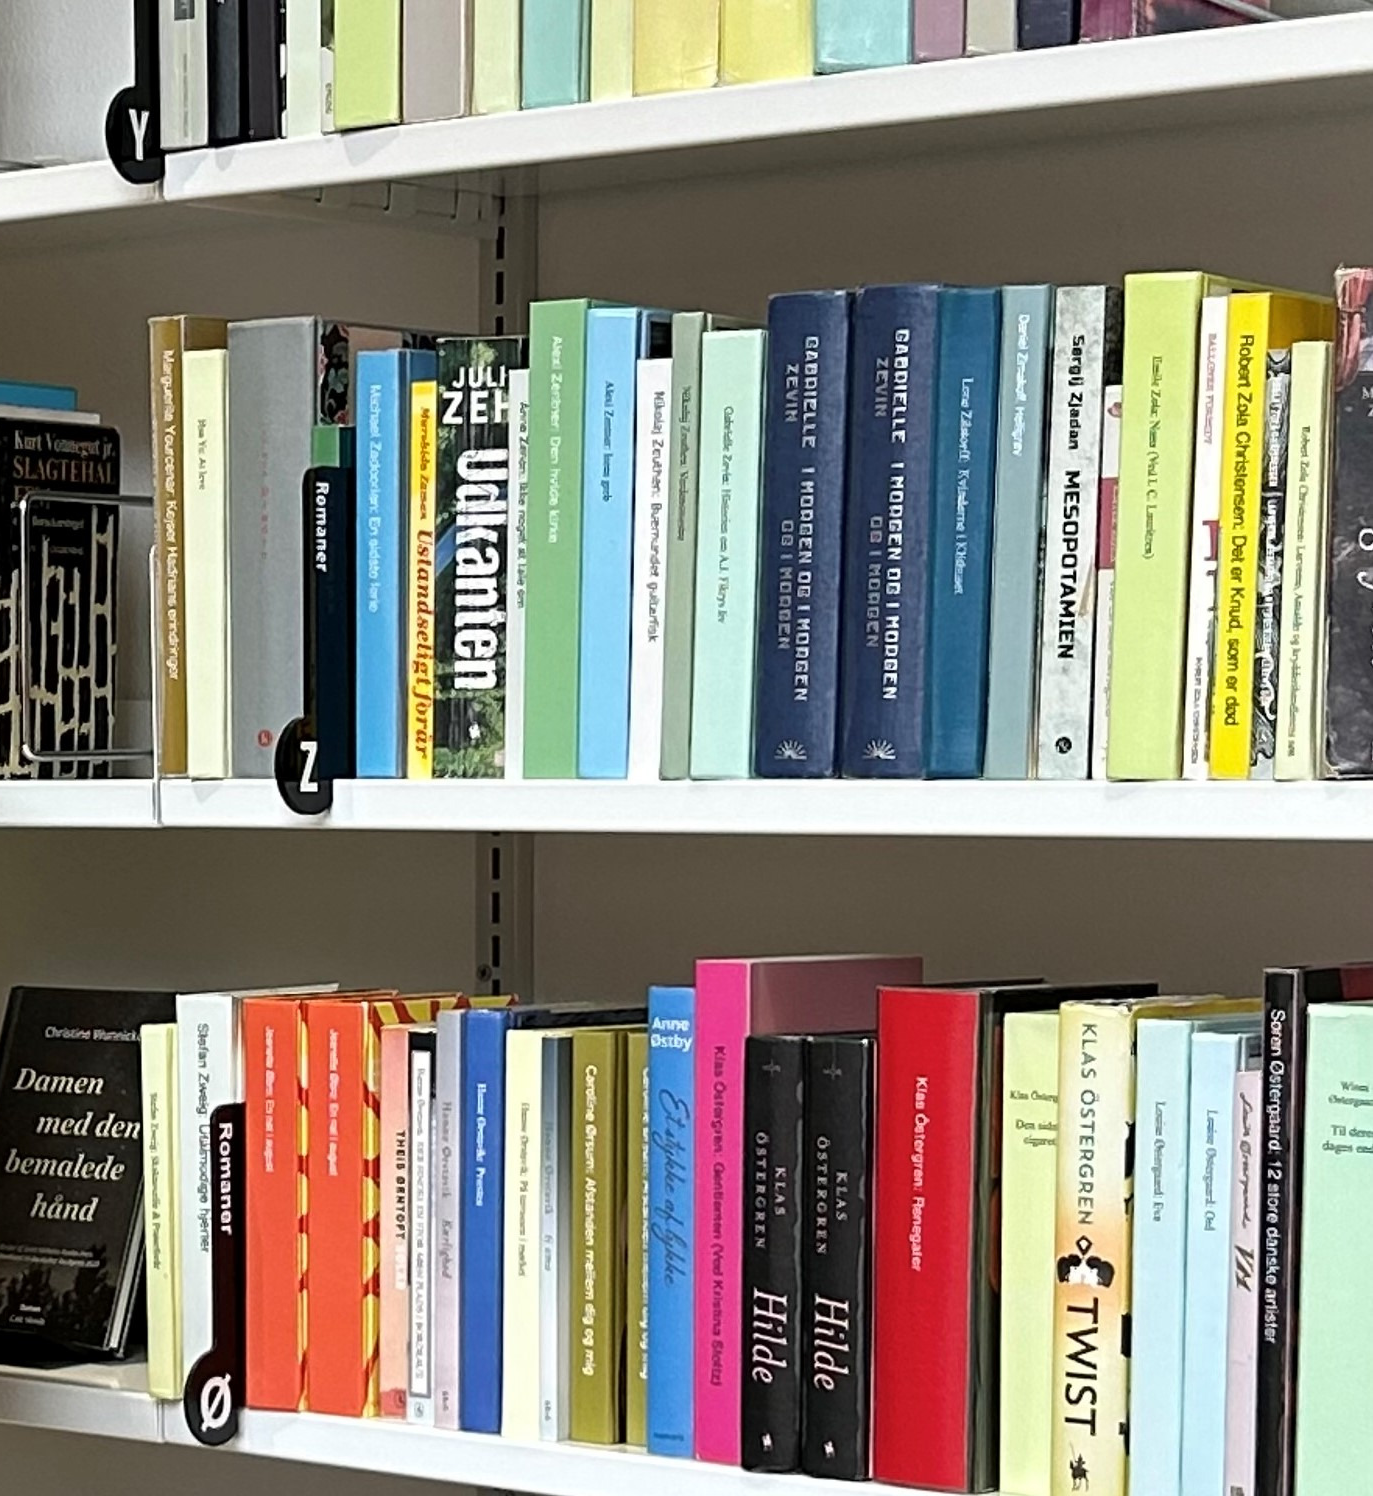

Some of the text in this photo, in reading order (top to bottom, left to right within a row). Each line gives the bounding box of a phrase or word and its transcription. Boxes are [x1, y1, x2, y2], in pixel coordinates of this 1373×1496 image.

[128, 108, 150, 161] Y
[785, 363, 797, 423] ZEVIN
[801, 336, 818, 449] GABRIELLE
[875, 357, 888, 418] ZEVIN
[892, 328, 909, 443] GABRIELLE
[1067, 335, 1085, 449] Sergij Zjadan
[13, 456, 116, 484] SLAGTEHAL
[14, 429, 42, 450] Kurt
[315, 481, 329, 572] Romaner
[798, 481, 814, 564] MORGEN
[888, 476, 903, 561] MORGEN
[1225, 334, 1253, 726] Robert Zola Christensen: Det er Knud, som er død
[452, 449, 508, 689] Udkanten
[797, 571, 812, 598] OG
[886, 568, 902, 595] OG
[1058, 470, 1080, 659] MESOPOTAMIEN
[778, 567, 792, 649] MORGEN
[866, 564, 881, 647] MORGEN
[412, 529, 435, 760] Ustandseligt forår
[794, 619, 810, 701] MORGEN
[883, 616, 899, 699] MORGEN
[300, 741, 318, 792] Z
[196, 1023, 210, 1068] Stefan
[651, 1033, 693, 1052] Østby
[652, 1016, 691, 1031] Anne
[13, 1068, 105, 1096] Damen
[196, 1072, 211, 1119] Zweig:
[584, 1065, 597, 1121] Caroline
[914, 1077, 927, 1110] Klas
[35, 1112, 141, 1140] med den
[1078, 1023, 1101, 1225] KLAS ÖSTERGREN
[5, 1148, 125, 1182] bemalede
[219, 1123, 233, 1235] Romaner
[755, 1132, 770, 1248] ÖSTERGREN
[774, 1167, 786, 1216] KLAS
[816, 1136, 830, 1255] ÖSTERGREN
[1263, 1009, 1286, 1344] Søren Østergaard: 12 store danske artister
[29, 1193, 99, 1223] hånd
[584, 1178, 597, 1245] Afstanden
[835, 1172, 848, 1221] KLAS
[581, 1303, 596, 1324] dig
[581, 1329, 595, 1345] og
[752, 1287, 788, 1384] Hilde
[814, 1293, 849, 1390] Hilde
[581, 1349, 596, 1376] mig
[1065, 1297, 1098, 1436] TWIST
[200, 1373, 232, 1433] Ø
